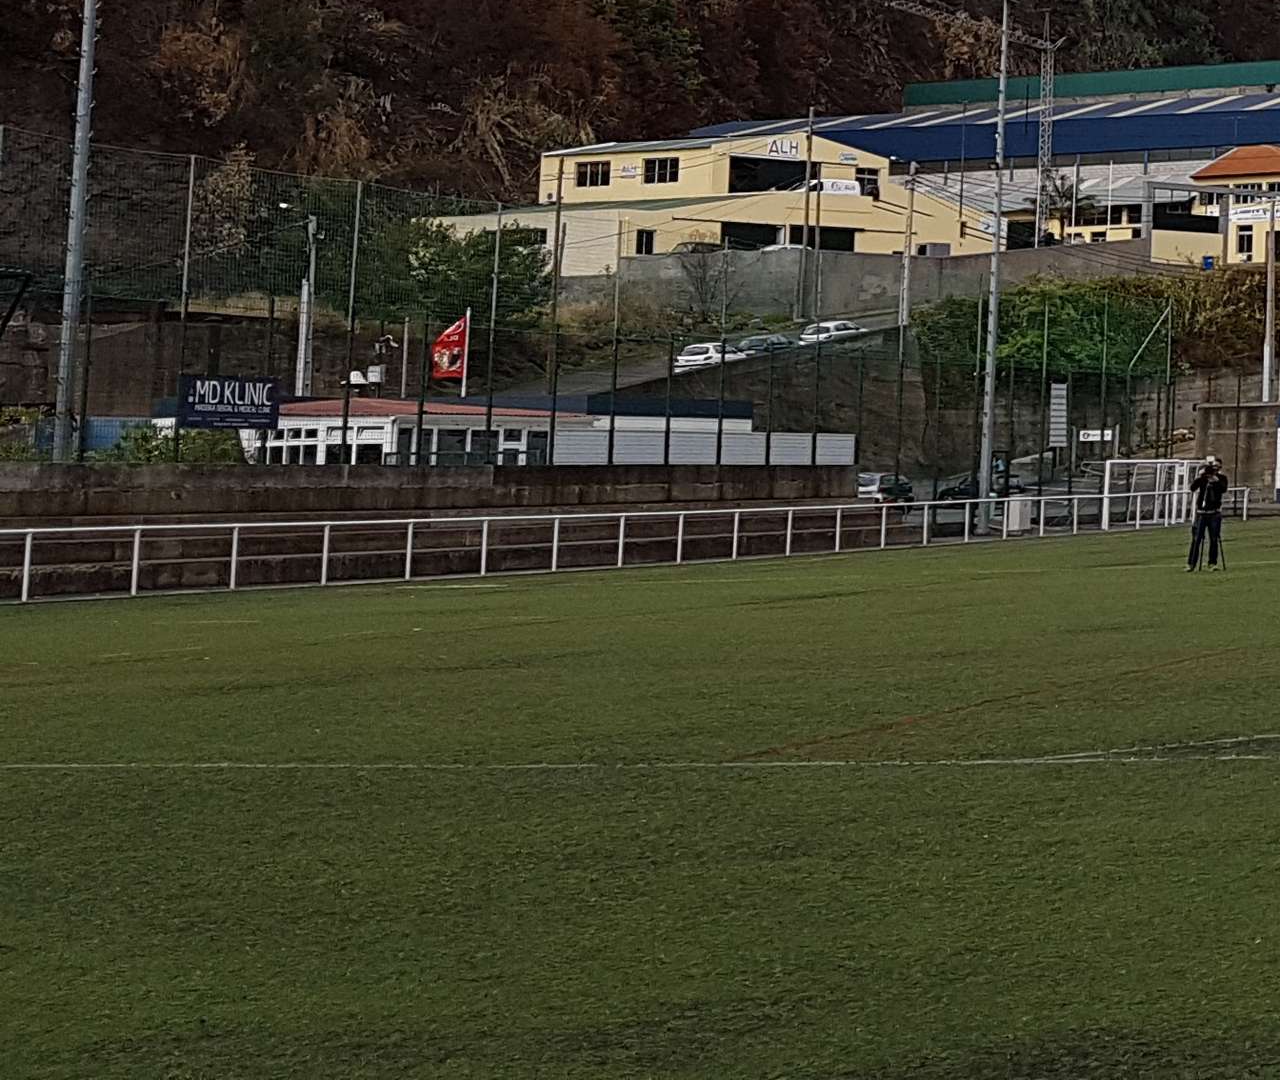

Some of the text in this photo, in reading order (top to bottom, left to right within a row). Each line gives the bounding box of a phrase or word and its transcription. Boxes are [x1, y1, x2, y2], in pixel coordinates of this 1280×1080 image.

[768, 139, 799, 157] ALH
[195, 380, 273, 406] MD KLINIC
